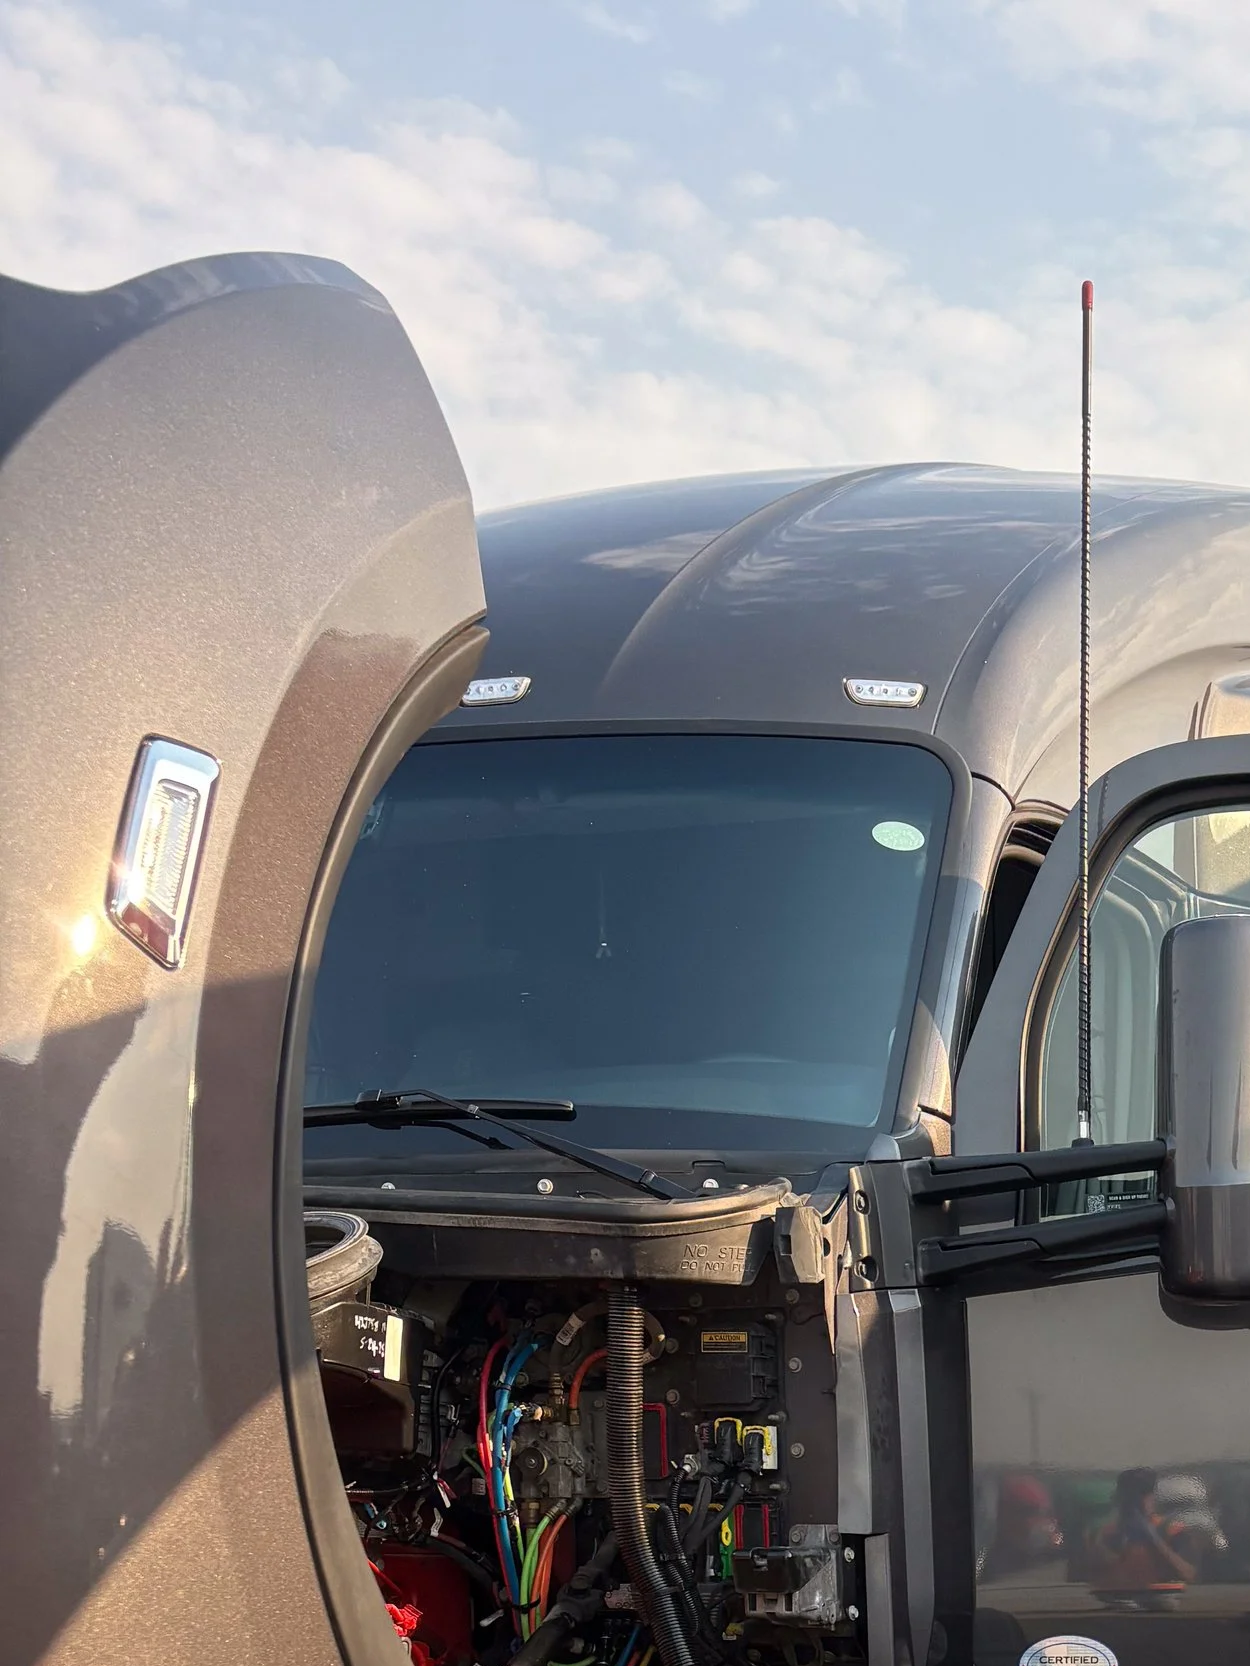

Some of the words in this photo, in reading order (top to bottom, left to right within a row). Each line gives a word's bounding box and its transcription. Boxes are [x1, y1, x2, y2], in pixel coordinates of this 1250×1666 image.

[683, 1244, 708, 1258] NO
[718, 1245, 753, 1261] STEP
[680, 1260, 698, 1271] DO
[704, 1261, 727, 1272] NOT
[1039, 1655, 1099, 1665] CERTIFIED
